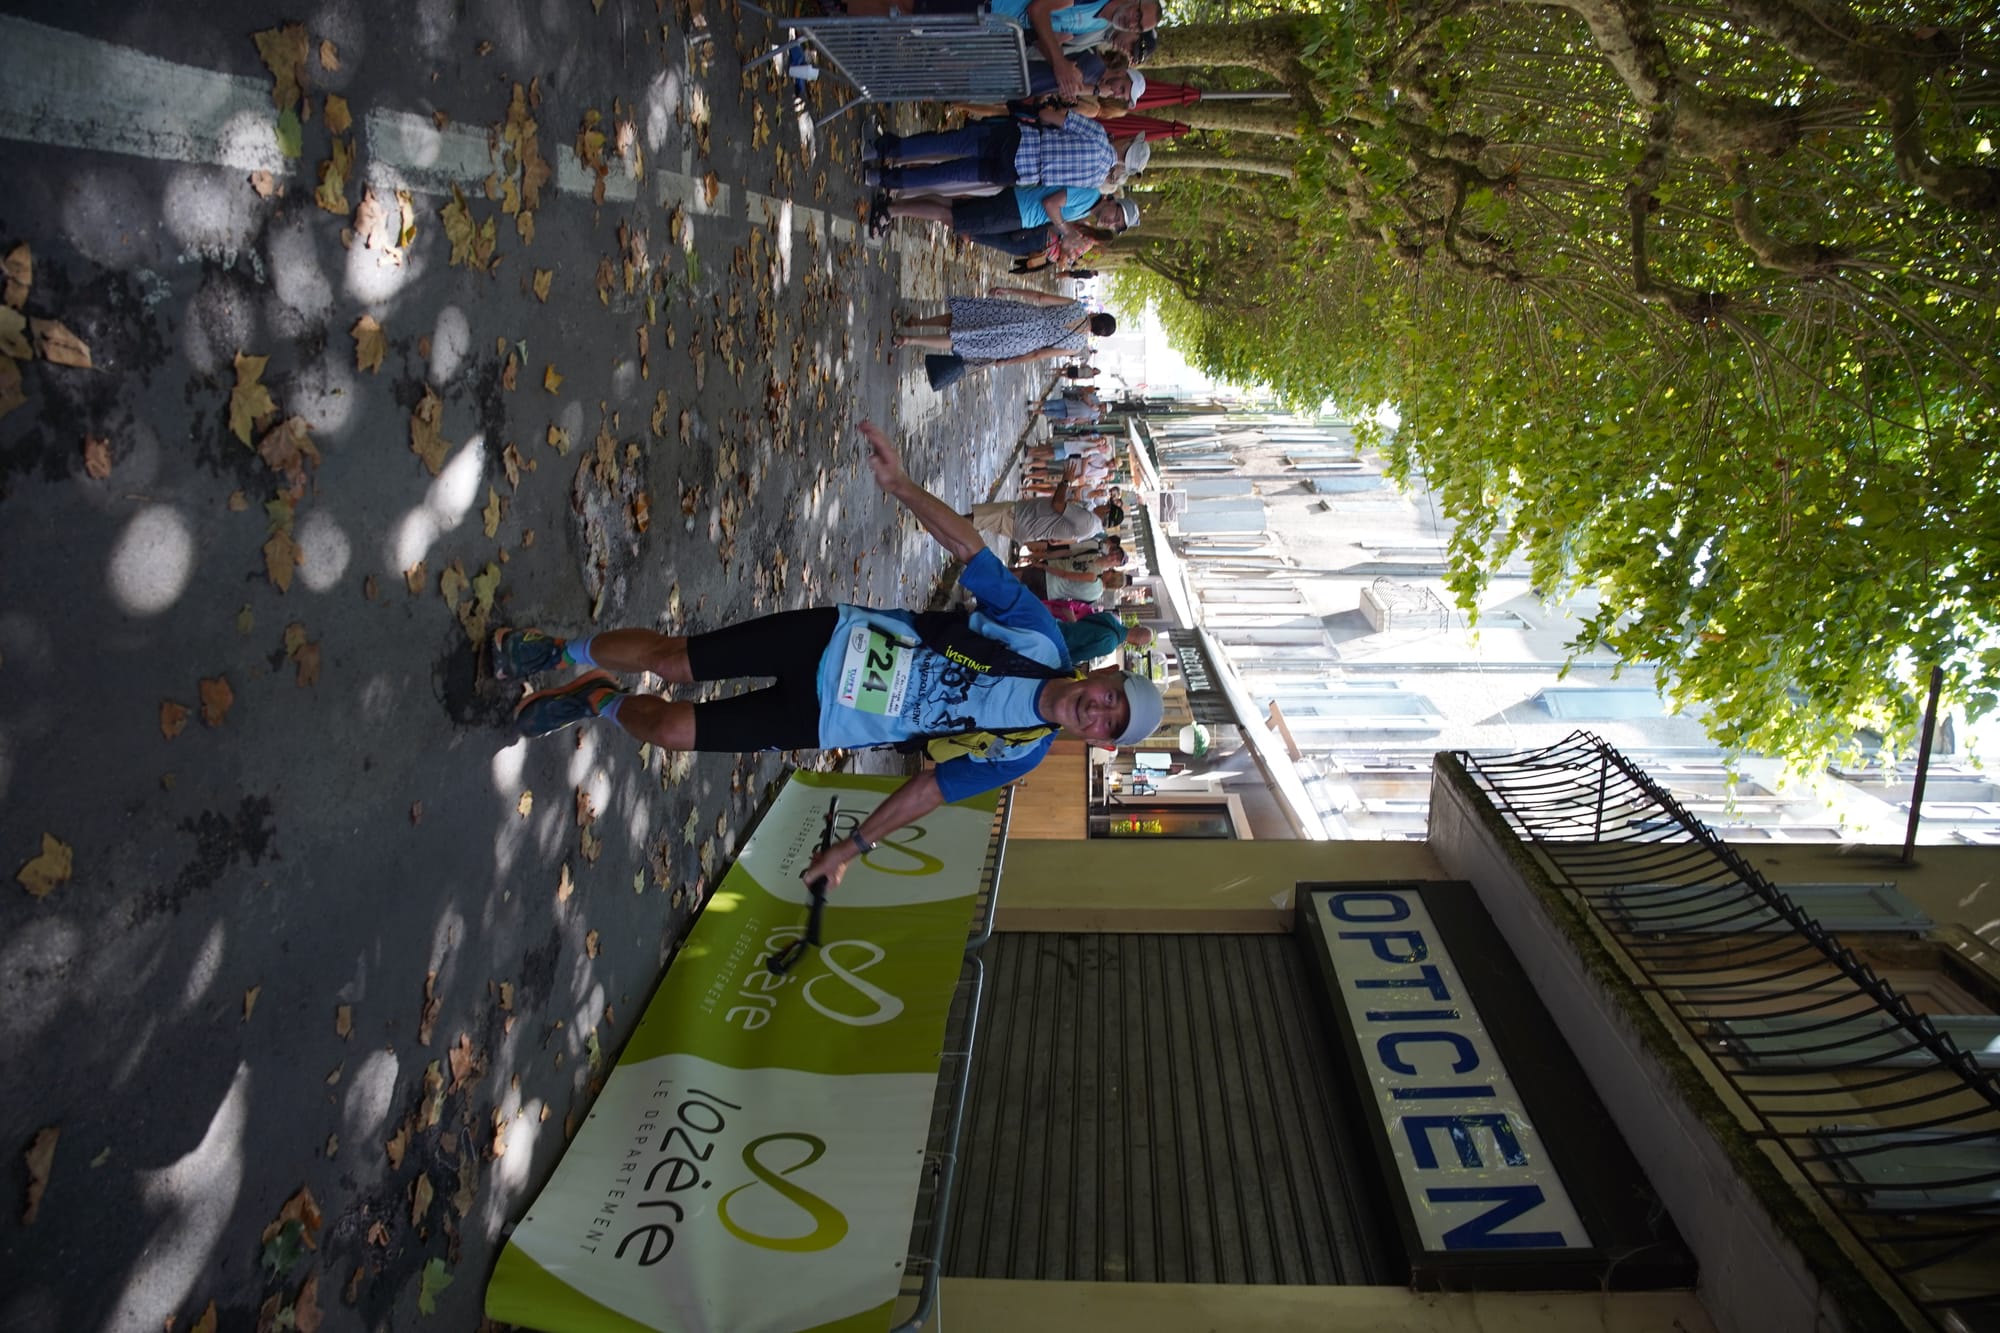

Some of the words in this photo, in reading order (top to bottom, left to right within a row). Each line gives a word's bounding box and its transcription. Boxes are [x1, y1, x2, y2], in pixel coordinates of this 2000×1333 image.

[700, 933, 752, 1014] DÉPARTEMENT
[745, 918, 760, 932] LE
[652, 1080, 673, 1099] LE
[1327, 893, 1567, 1250] OPTICIEN
[579, 1110, 659, 1255] DÉPARTEMENT
[613, 1089, 742, 1267] lozère
